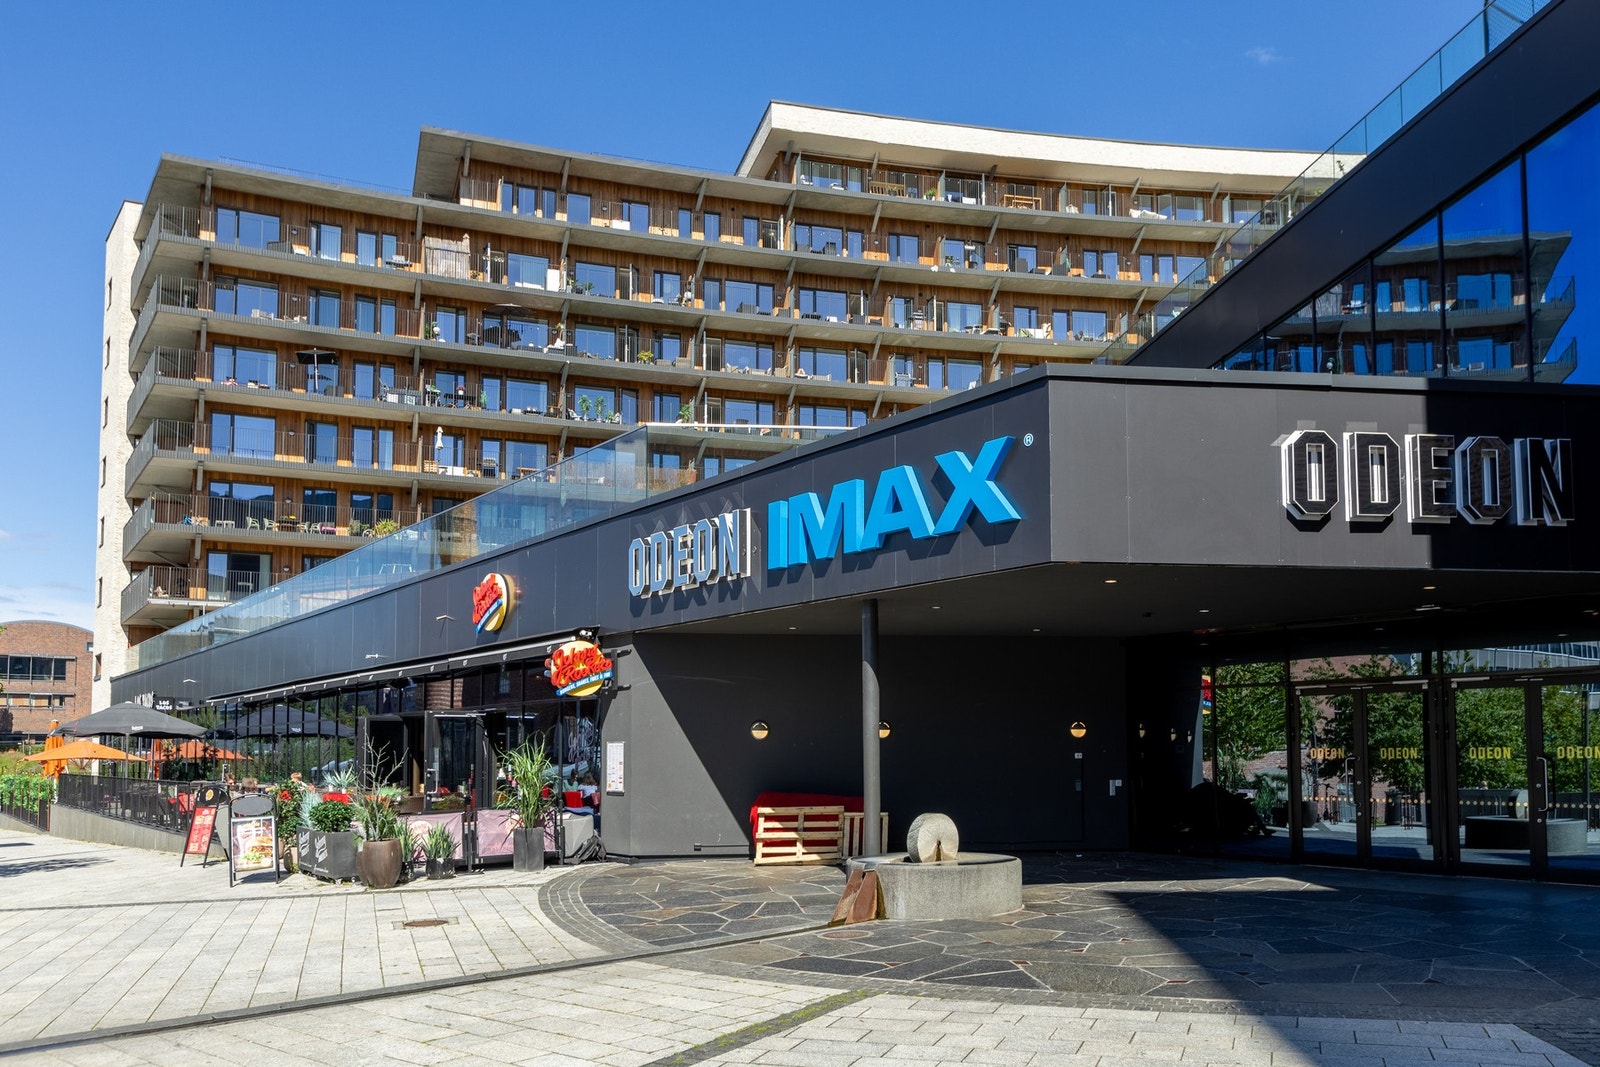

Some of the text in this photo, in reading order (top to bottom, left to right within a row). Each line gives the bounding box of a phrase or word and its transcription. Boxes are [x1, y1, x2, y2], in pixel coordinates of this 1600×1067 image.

[1281, 430, 1575, 526] ODEON
[628, 507, 751, 599] ODEON
[1310, 748, 1345, 759] ODEON
[1380, 747, 1418, 759] ODEON
[1469, 746, 1512, 759] ODEON
[1556, 746, 1600, 758] ODEON
